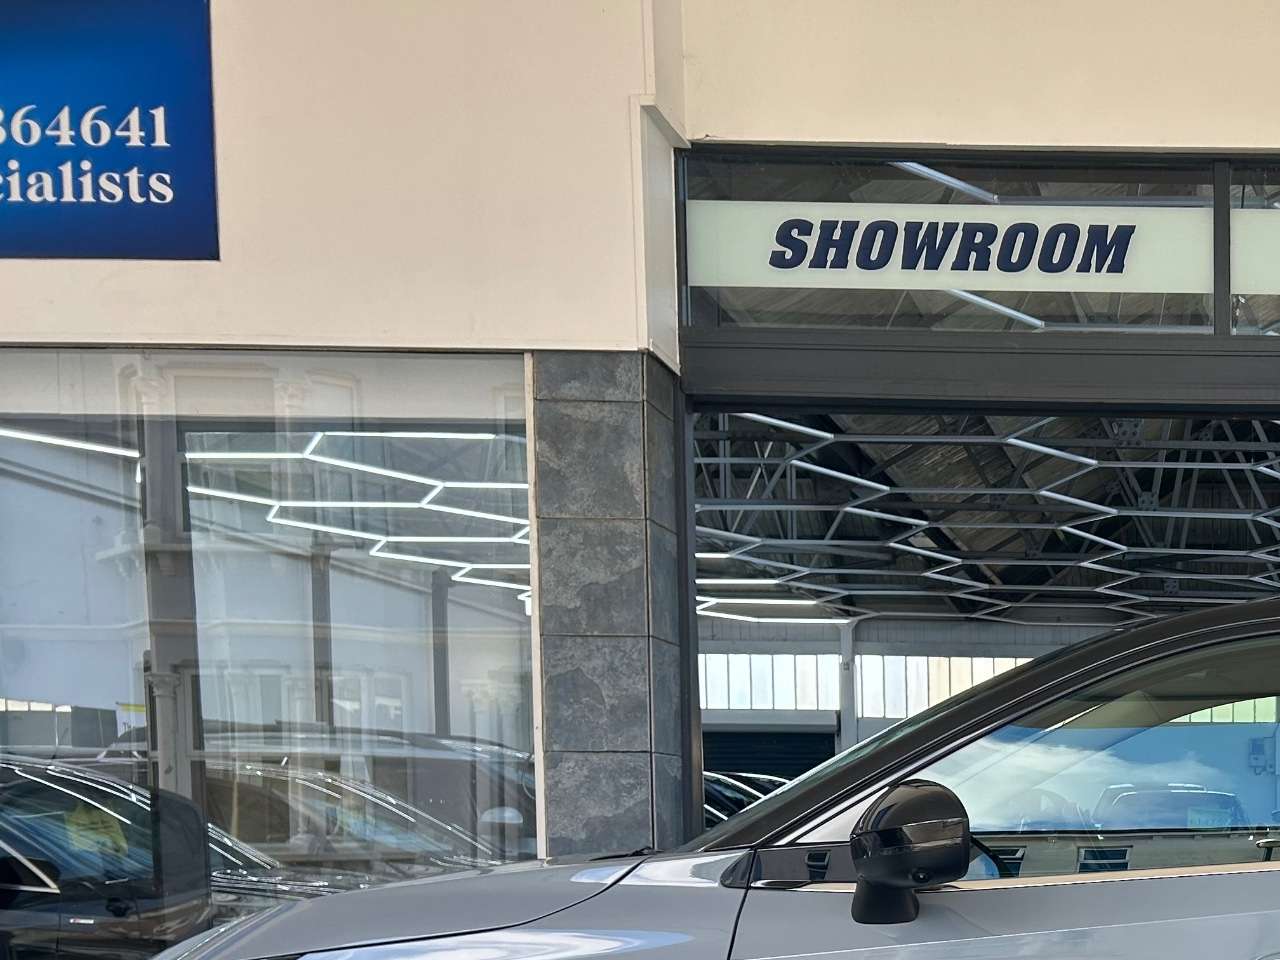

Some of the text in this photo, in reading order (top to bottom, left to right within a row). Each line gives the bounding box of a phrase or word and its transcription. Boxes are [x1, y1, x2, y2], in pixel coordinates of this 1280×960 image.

[0, 105, 172, 147] 64641
[0, 159, 174, 204] ialists
[768, 219, 1137, 275] SHOWROOM
